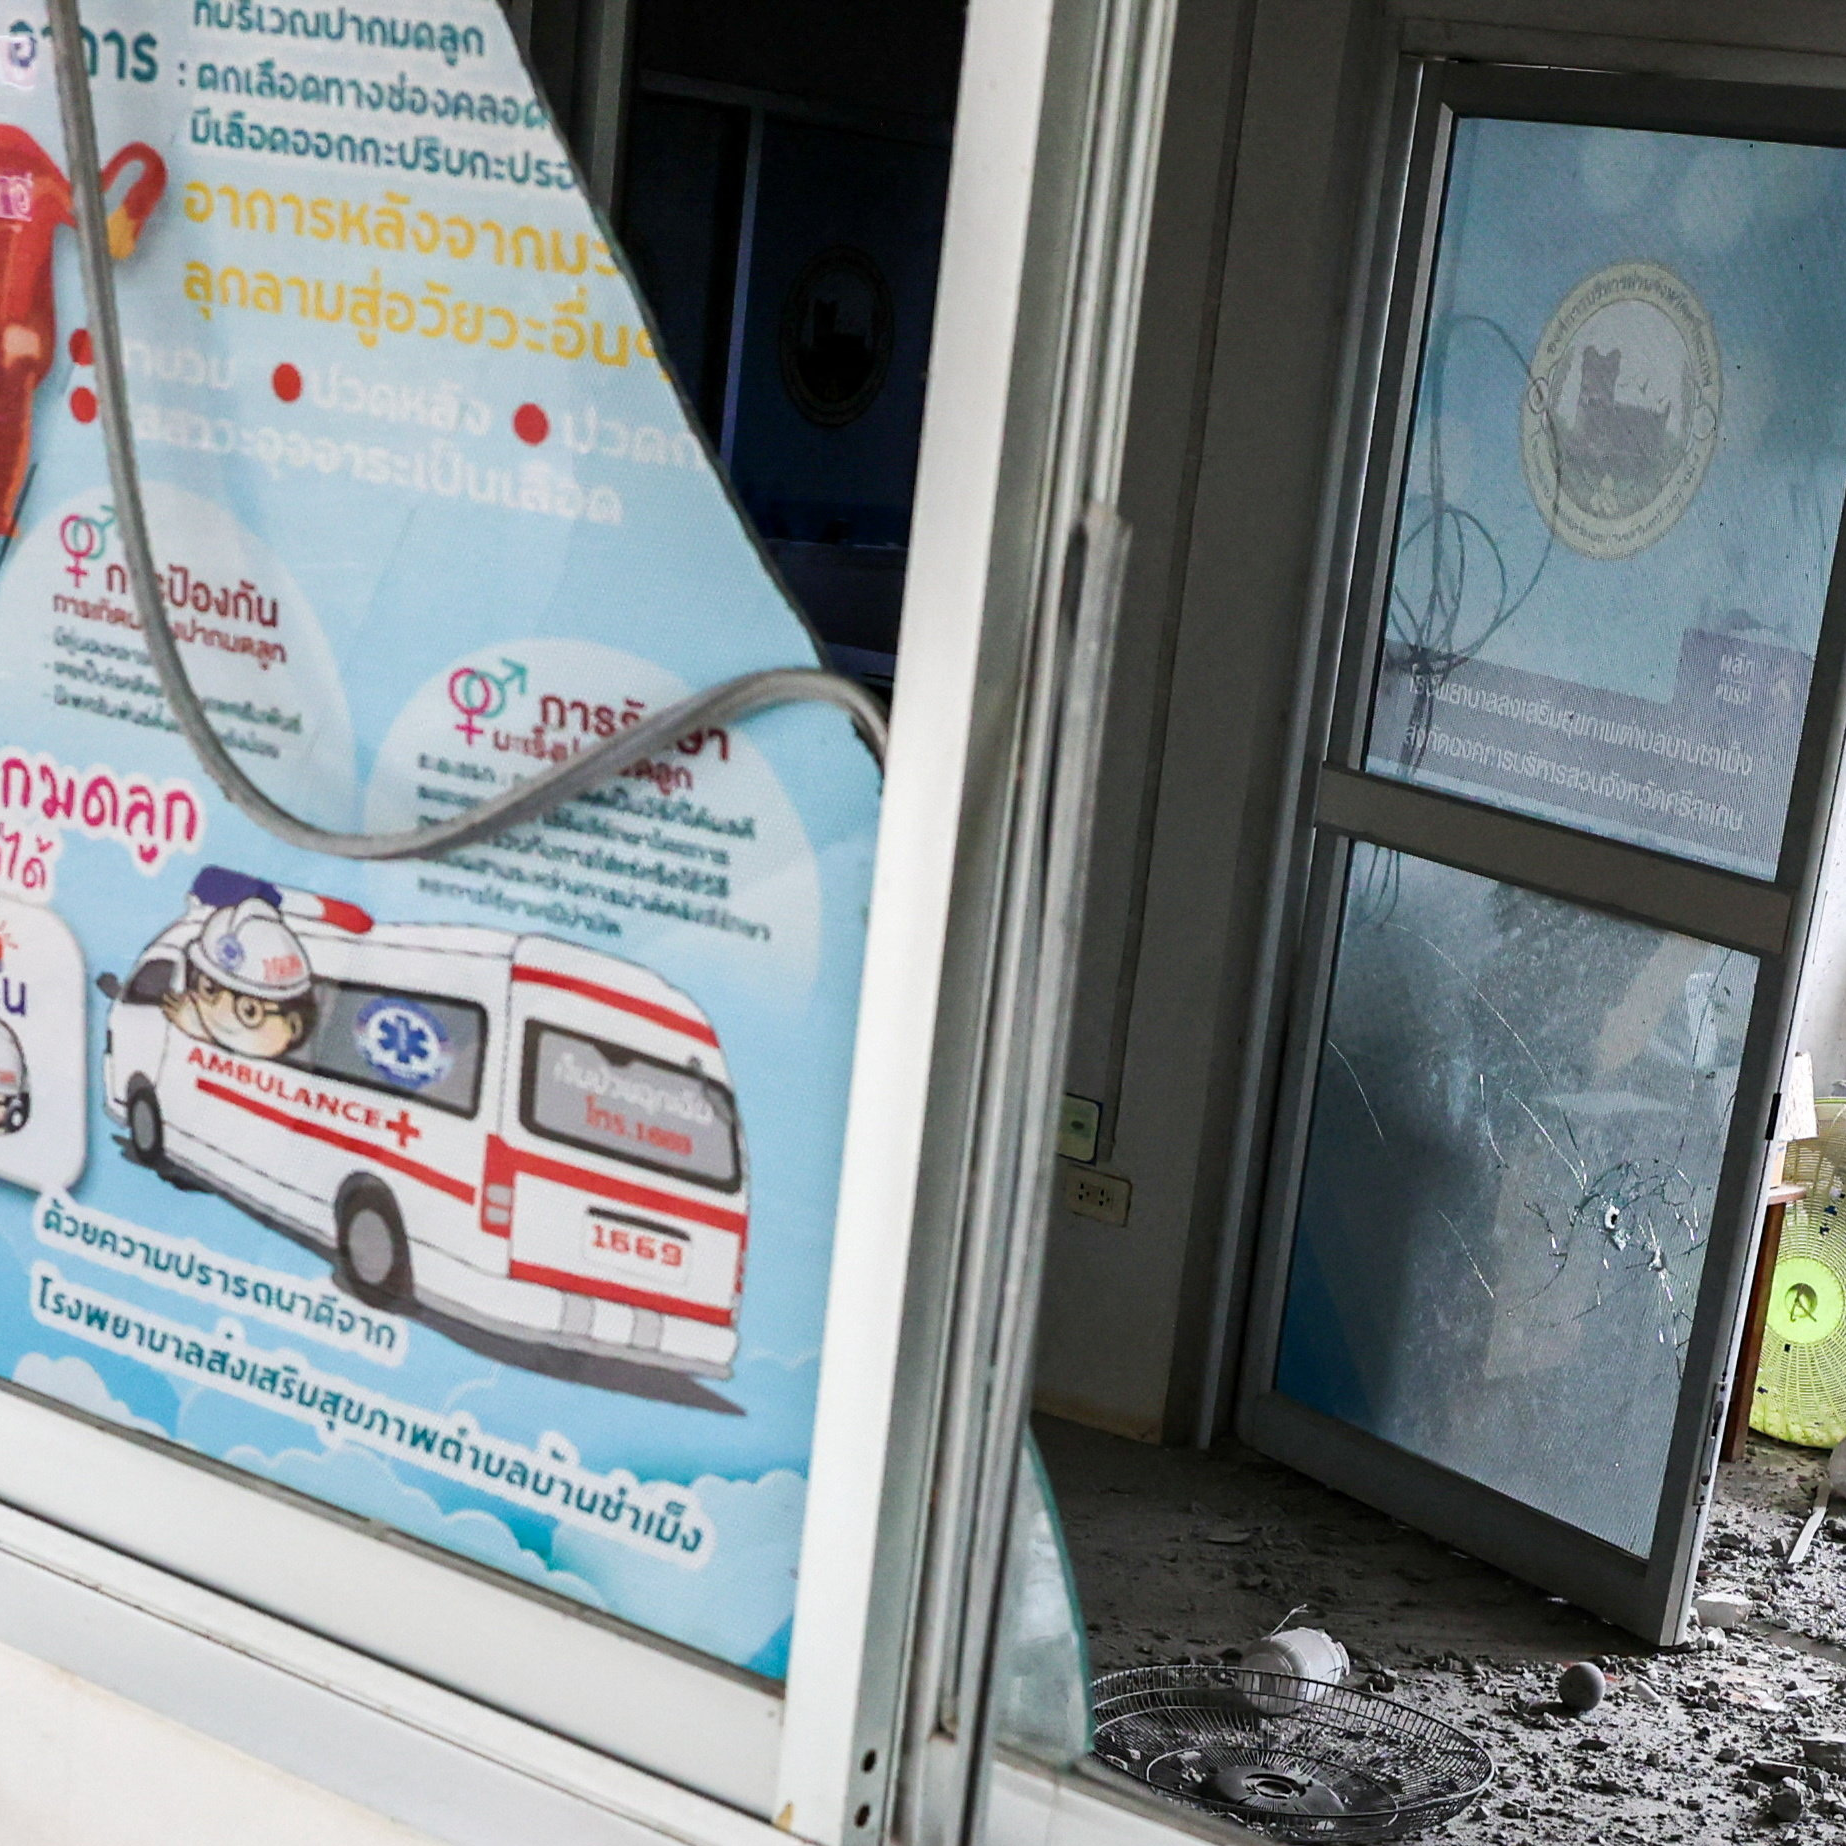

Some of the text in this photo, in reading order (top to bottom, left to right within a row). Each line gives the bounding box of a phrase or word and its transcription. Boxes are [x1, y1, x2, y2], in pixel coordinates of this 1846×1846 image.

[106, 562, 279, 629] กป้องกัน
[187, 1046, 381, 1128] AMBULANCE
[42, 1196, 398, 1355] ด้วยความปรารถนาดีจาก
[590, 1223, 685, 1269] 1669
